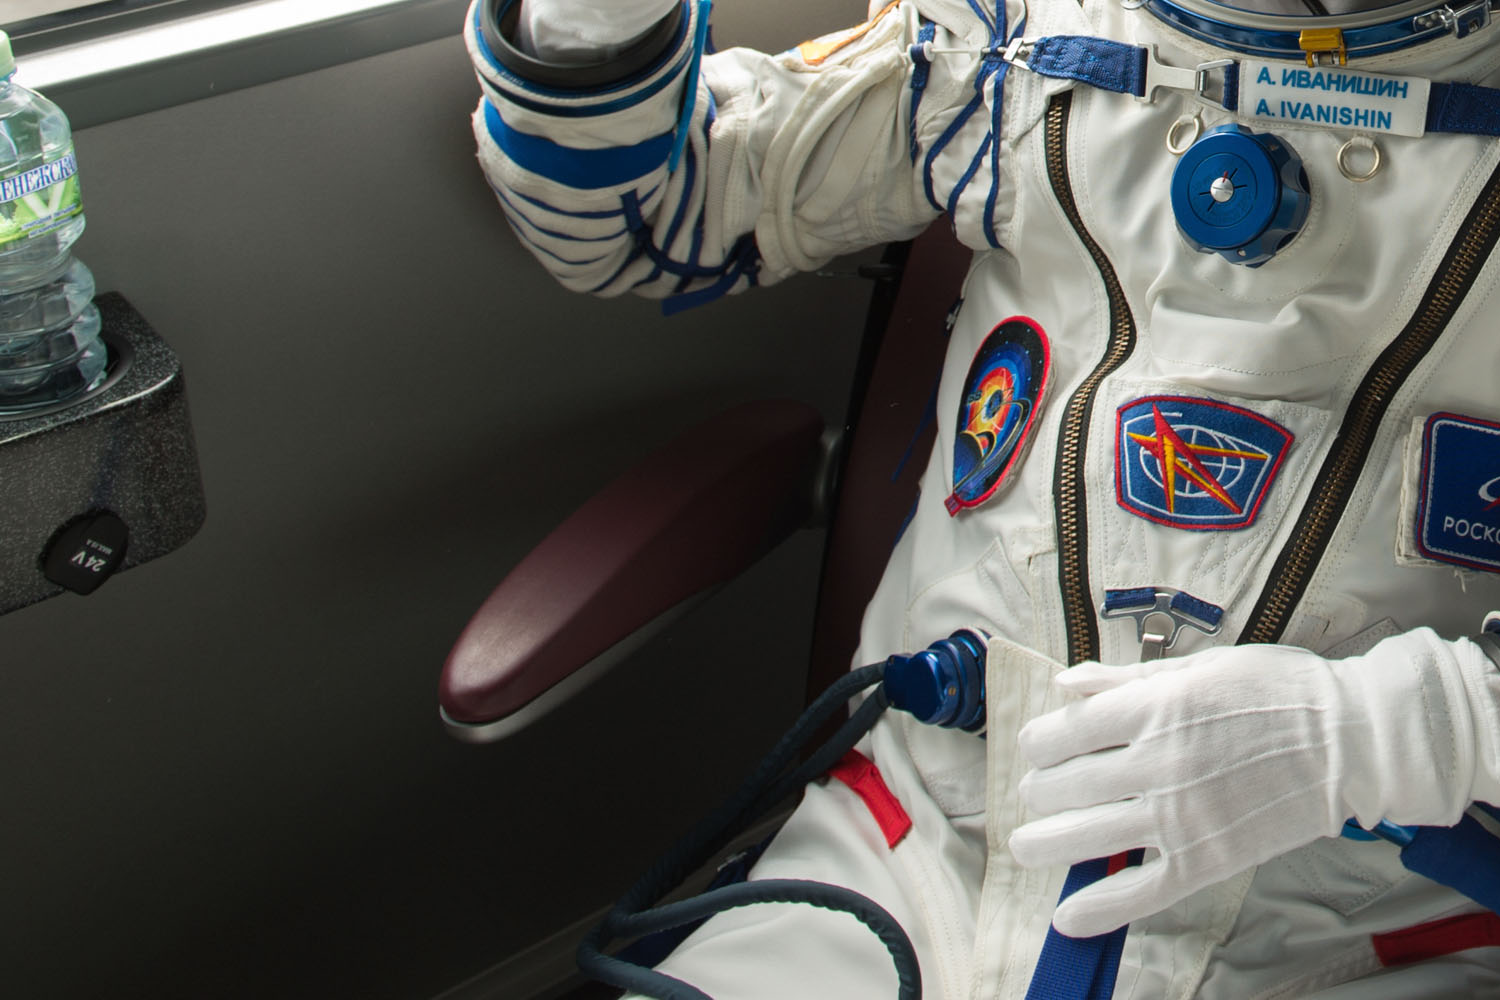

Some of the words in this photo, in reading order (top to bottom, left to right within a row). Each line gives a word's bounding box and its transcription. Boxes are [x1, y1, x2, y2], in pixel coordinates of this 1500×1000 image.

[1256, 66, 1276, 86] А.
[1281, 68, 1409, 99] ИВАНИШИН
[1255, 98, 1276, 117] A.
[1280, 100, 1392, 130] IVANISHIN
[71, 550, 87, 565] V
[84, 555, 107, 572] 24
